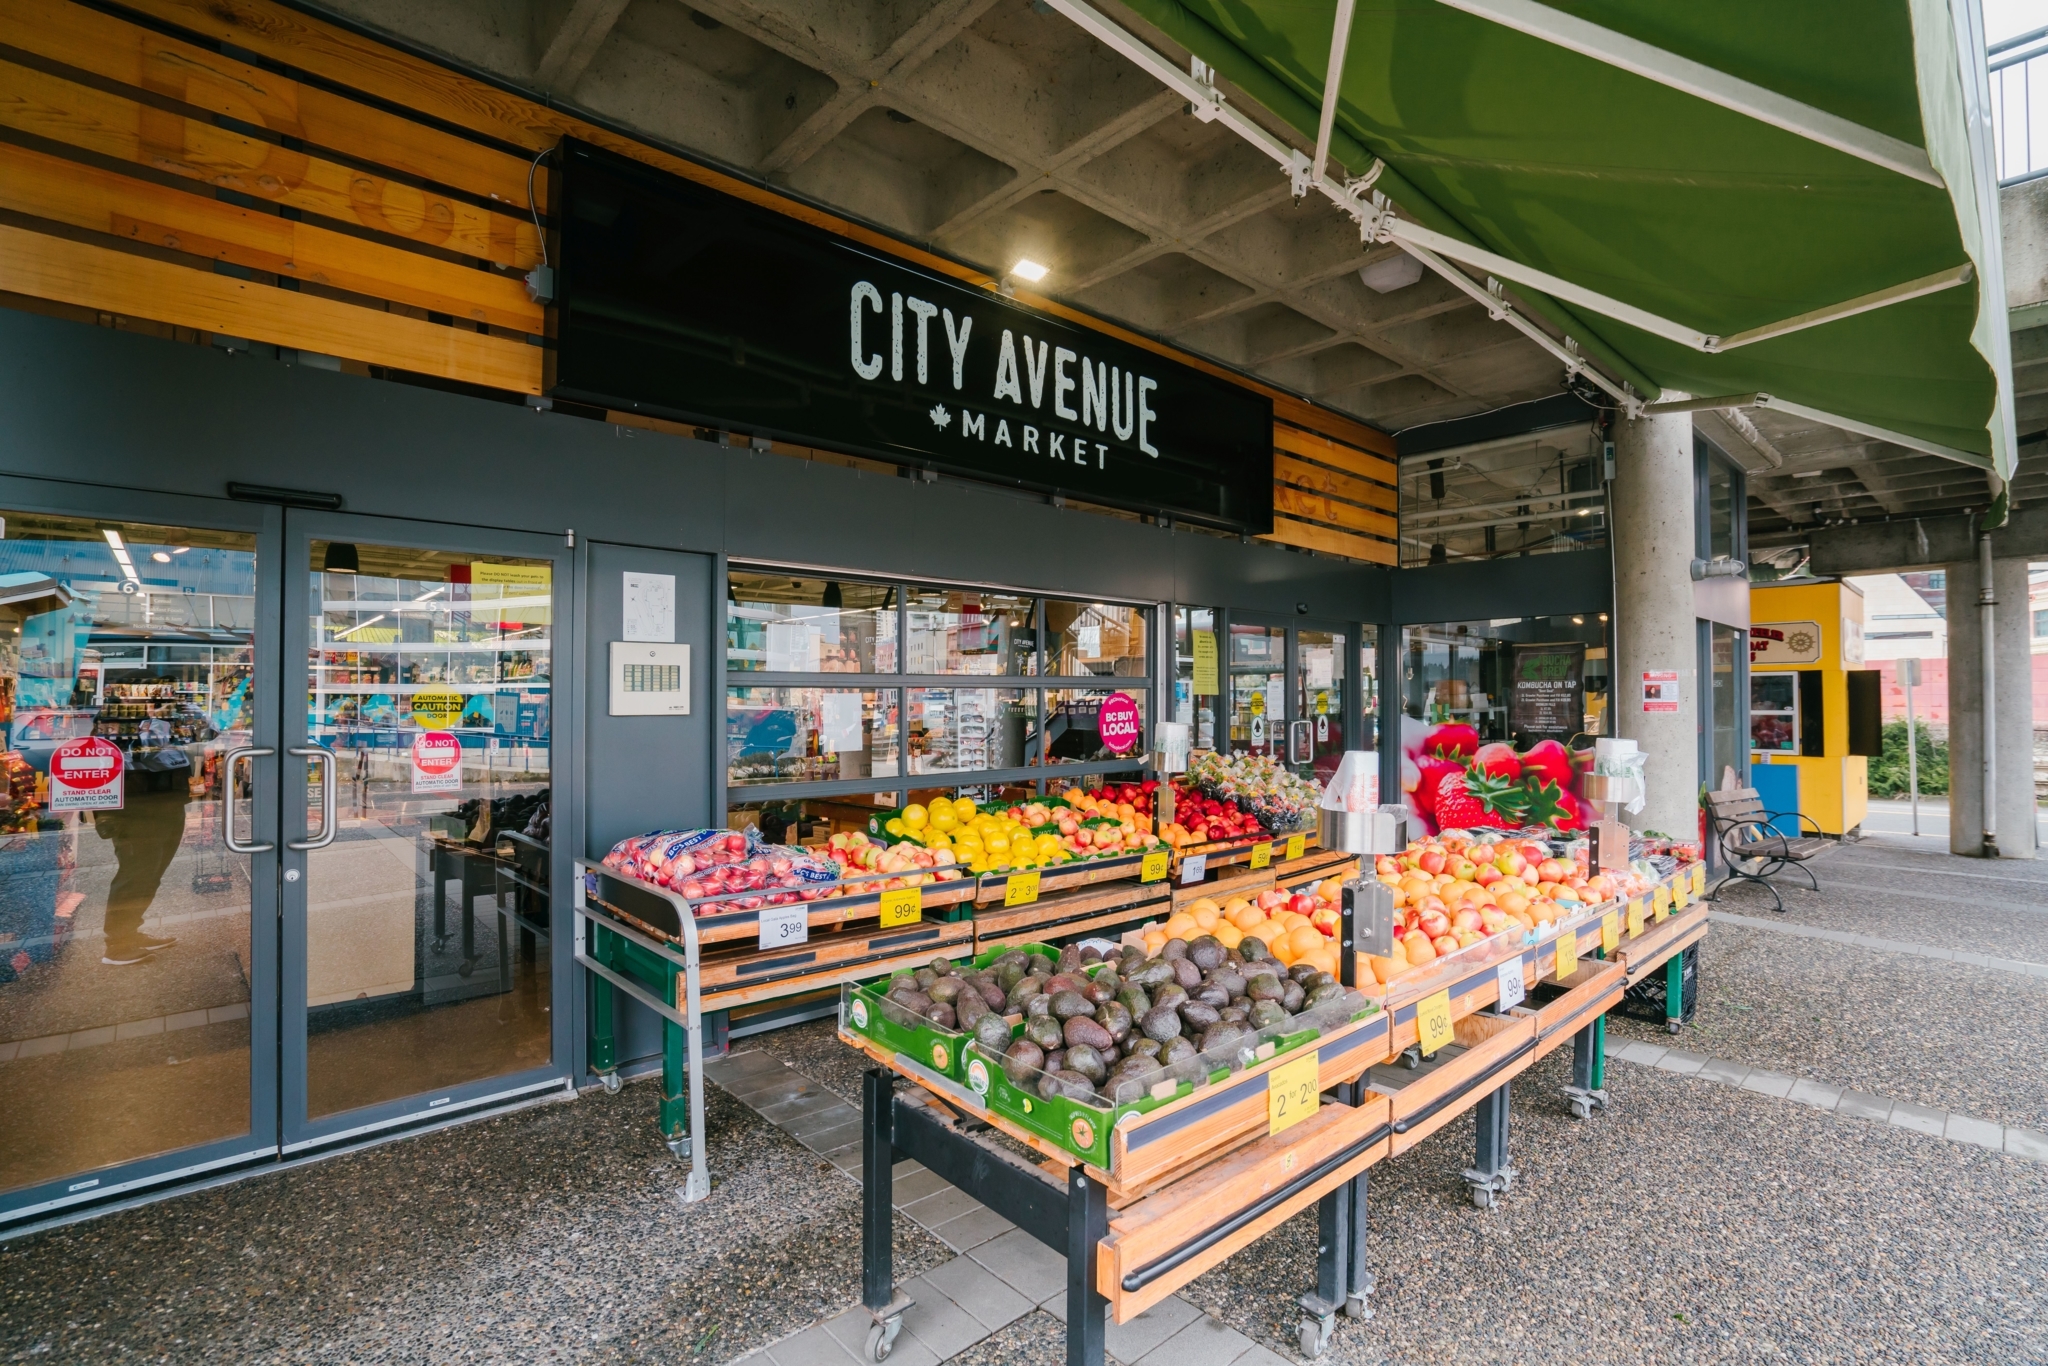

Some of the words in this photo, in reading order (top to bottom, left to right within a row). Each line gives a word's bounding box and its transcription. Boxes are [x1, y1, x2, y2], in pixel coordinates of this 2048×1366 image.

[851, 281, 972, 389] CITY
[993, 329, 1159, 458] AVENUE
[962, 409, 1108, 469] MARKET
[123, 582, 134, 594] 6
[429, 602, 438, 612] 5
[1542, 654, 1572, 666] BUCHA
[1542, 666, 1568, 677] BREW
[1517, 681, 1552, 689] KOMBUCHA
[1564, 681, 1577, 689] TAP
[414, 703, 461, 711] CAUTION
[1105, 712, 1117, 722] BC
[1117, 711, 1134, 721] BUY
[1103, 721, 1138, 736] LOCAL
[435, 739, 455, 747] NOT
[61, 747, 81, 757] DO
[85, 747, 114, 756] NOT
[421, 758, 452, 767] ENTER
[64, 769, 109, 779] ENTER
[54, 795, 97, 803] AUTOMATIC
[668, 842, 685, 856] BC'S
[684, 835, 703, 847] BEST
[809, 871, 827, 880] BEST
[1010, 887, 1017, 899] 2
[894, 903, 917, 919] 99¢
[1507, 977, 1522, 998] 99¢
[1430, 1014, 1448, 1039] 99¢
[1277, 1094, 1287, 1118] 2
[1289, 1089, 1297, 1099] for
